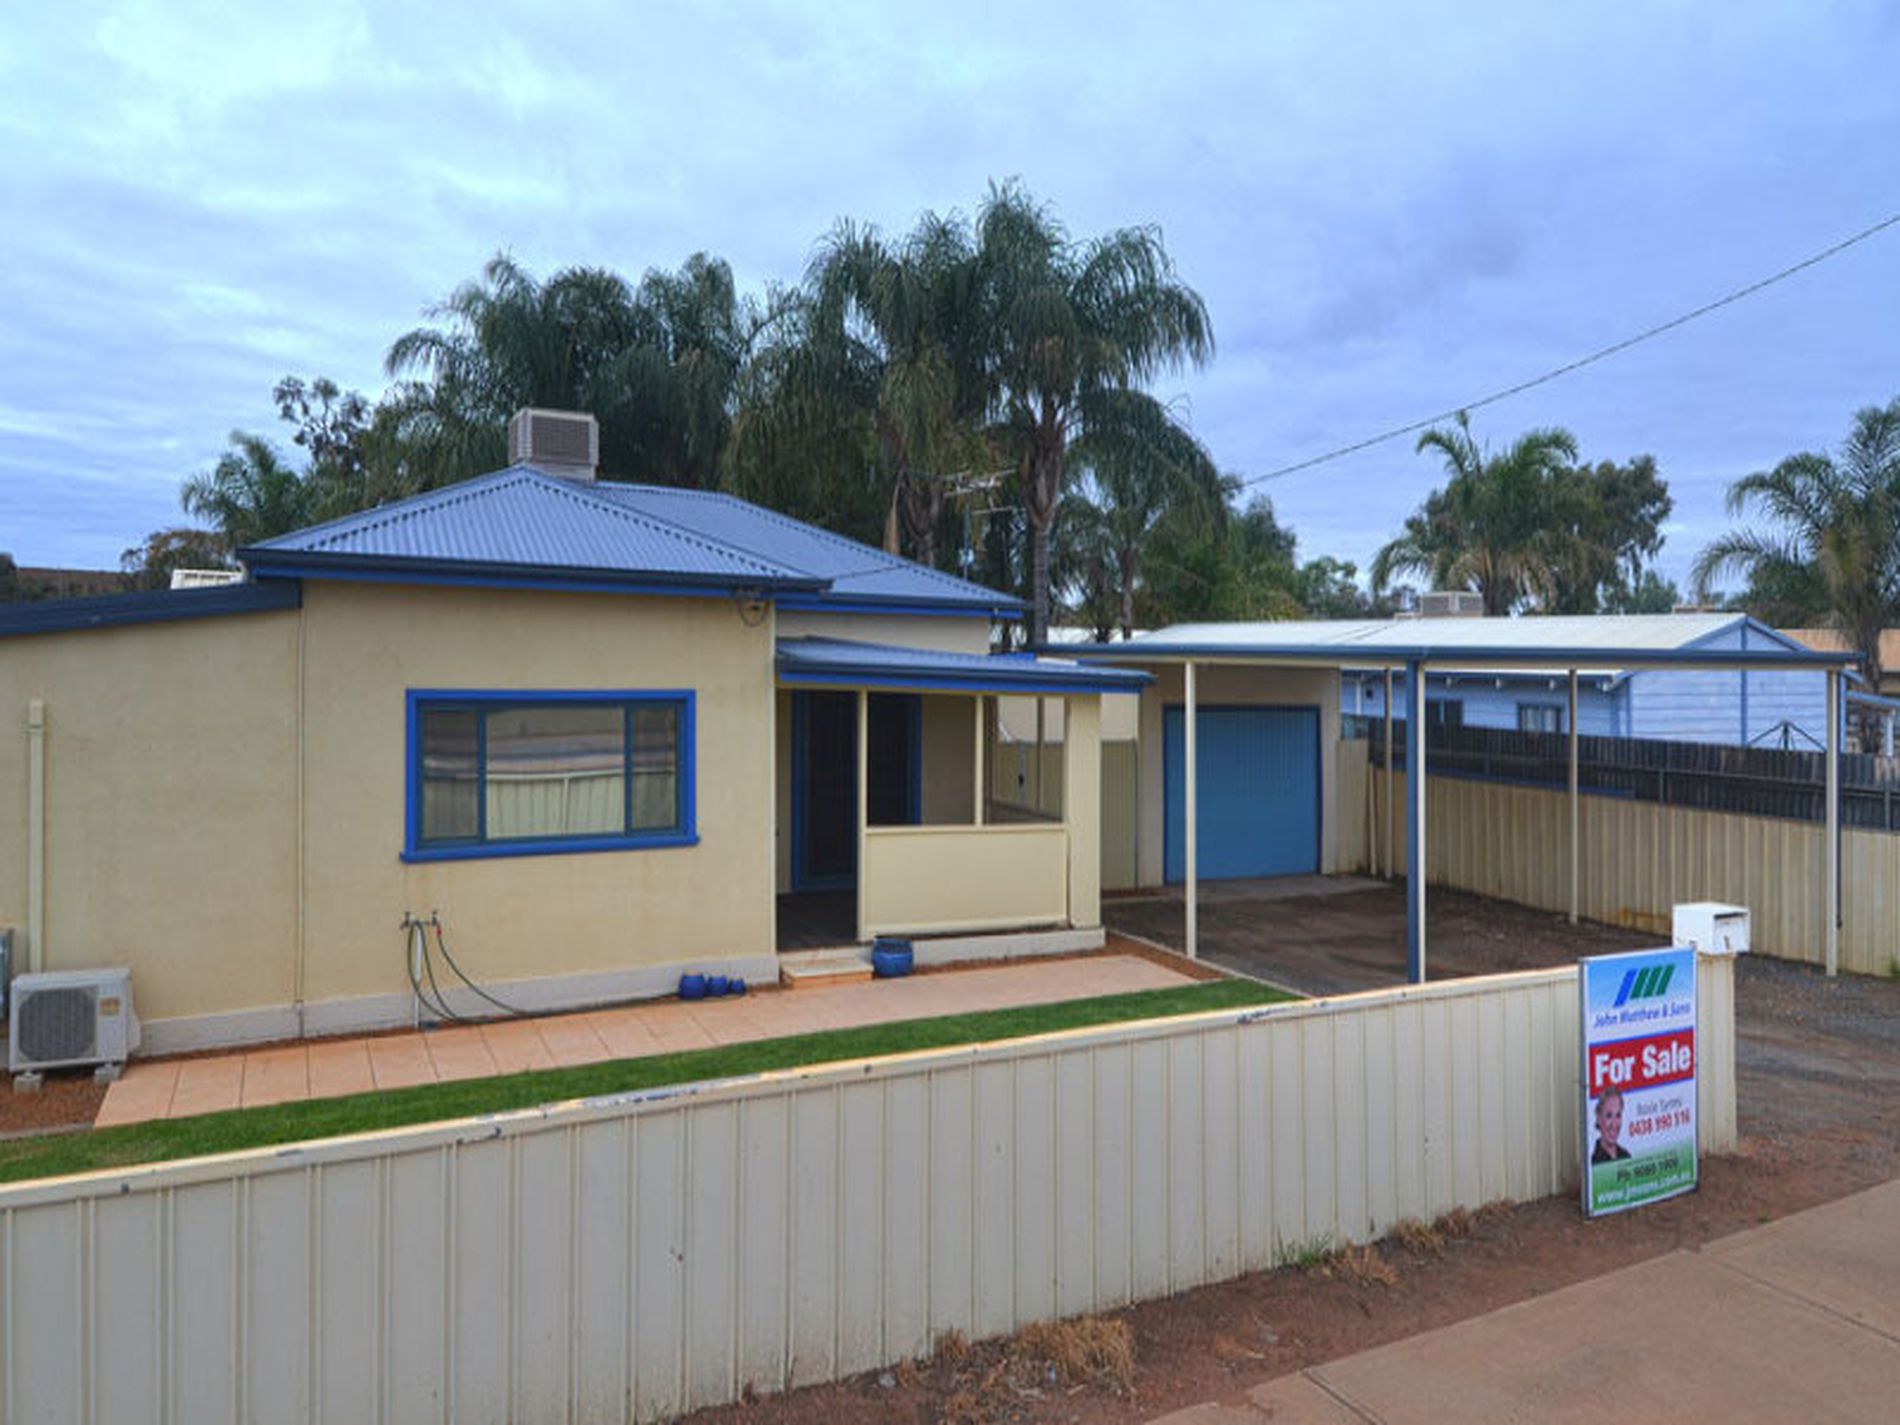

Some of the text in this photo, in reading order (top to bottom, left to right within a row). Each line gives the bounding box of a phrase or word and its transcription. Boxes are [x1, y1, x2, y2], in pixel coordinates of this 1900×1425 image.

[1594, 1010, 1617, 1028] John
[1662, 1005, 1669, 1017] &
[1670, 1002, 1691, 1017] Sons
[1594, 1040, 1691, 1087] For Sale
